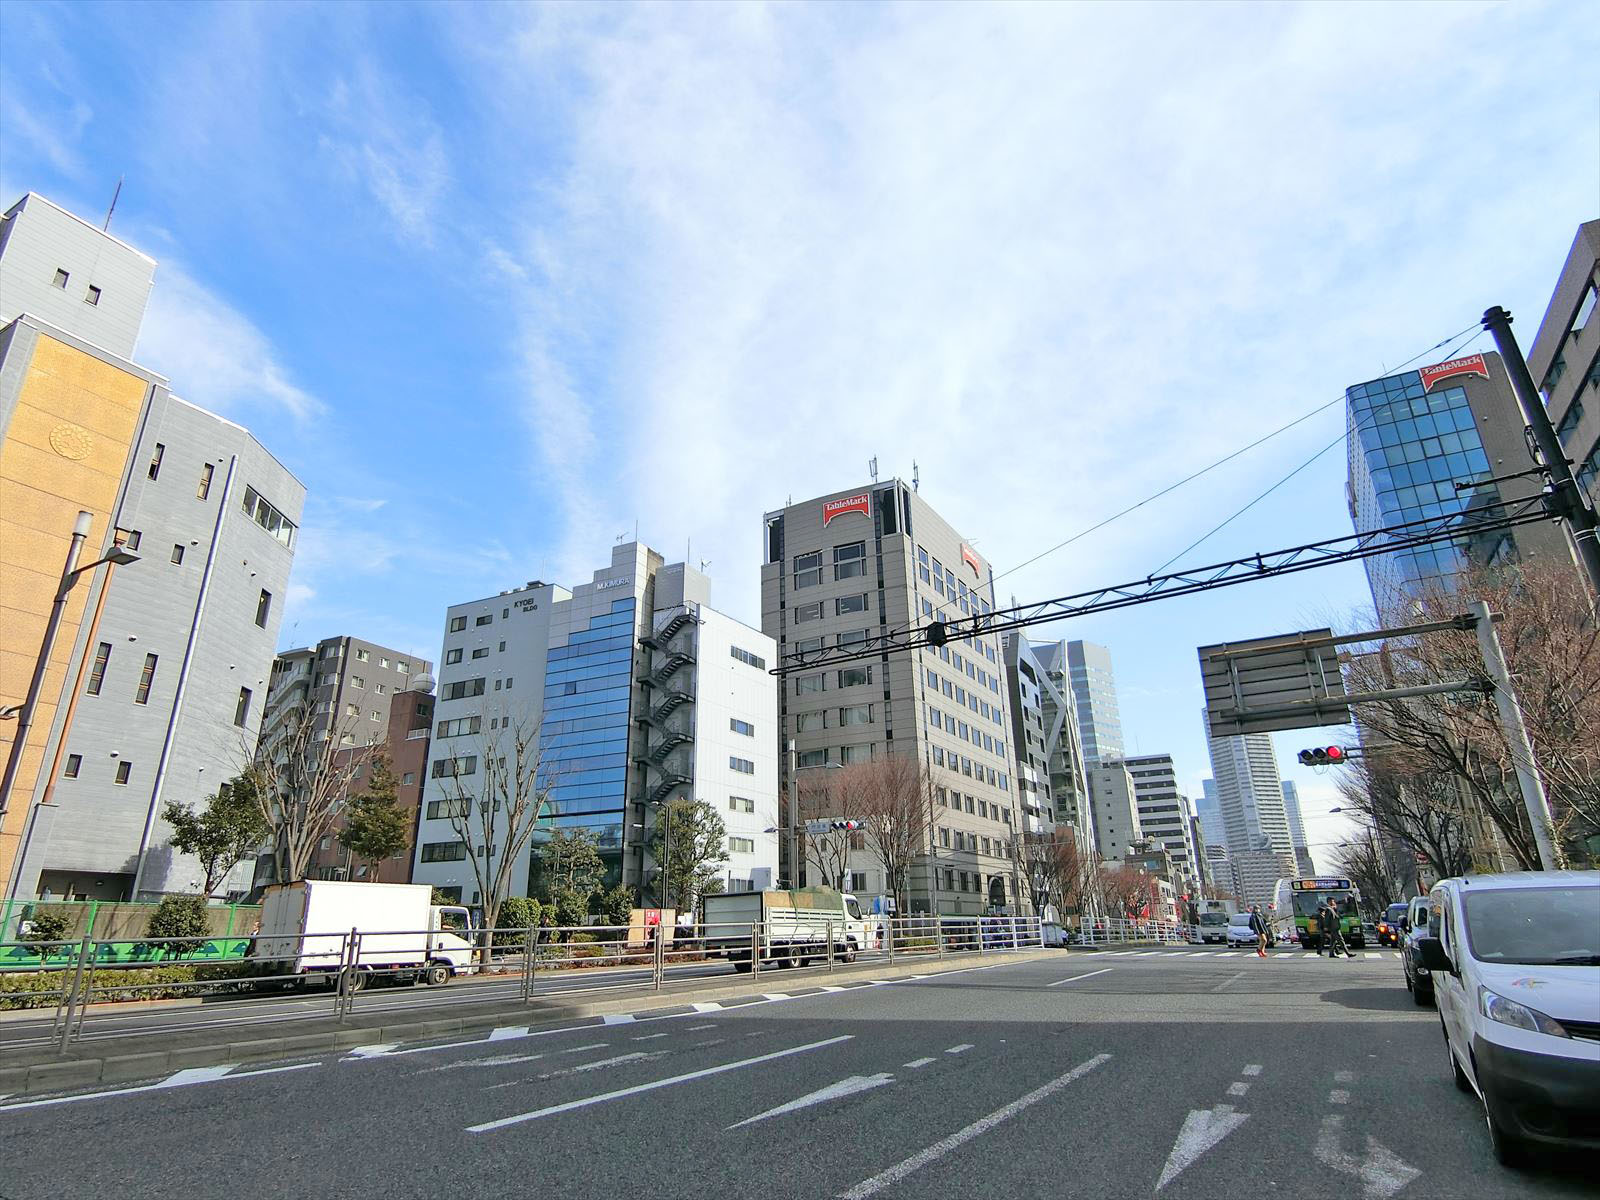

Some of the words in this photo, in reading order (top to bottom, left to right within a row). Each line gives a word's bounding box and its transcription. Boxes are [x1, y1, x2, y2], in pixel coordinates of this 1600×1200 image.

[1423, 356, 1481, 374] TableMark
[826, 496, 867, 510] TableMark
[514, 598, 534, 608] KYOEI
